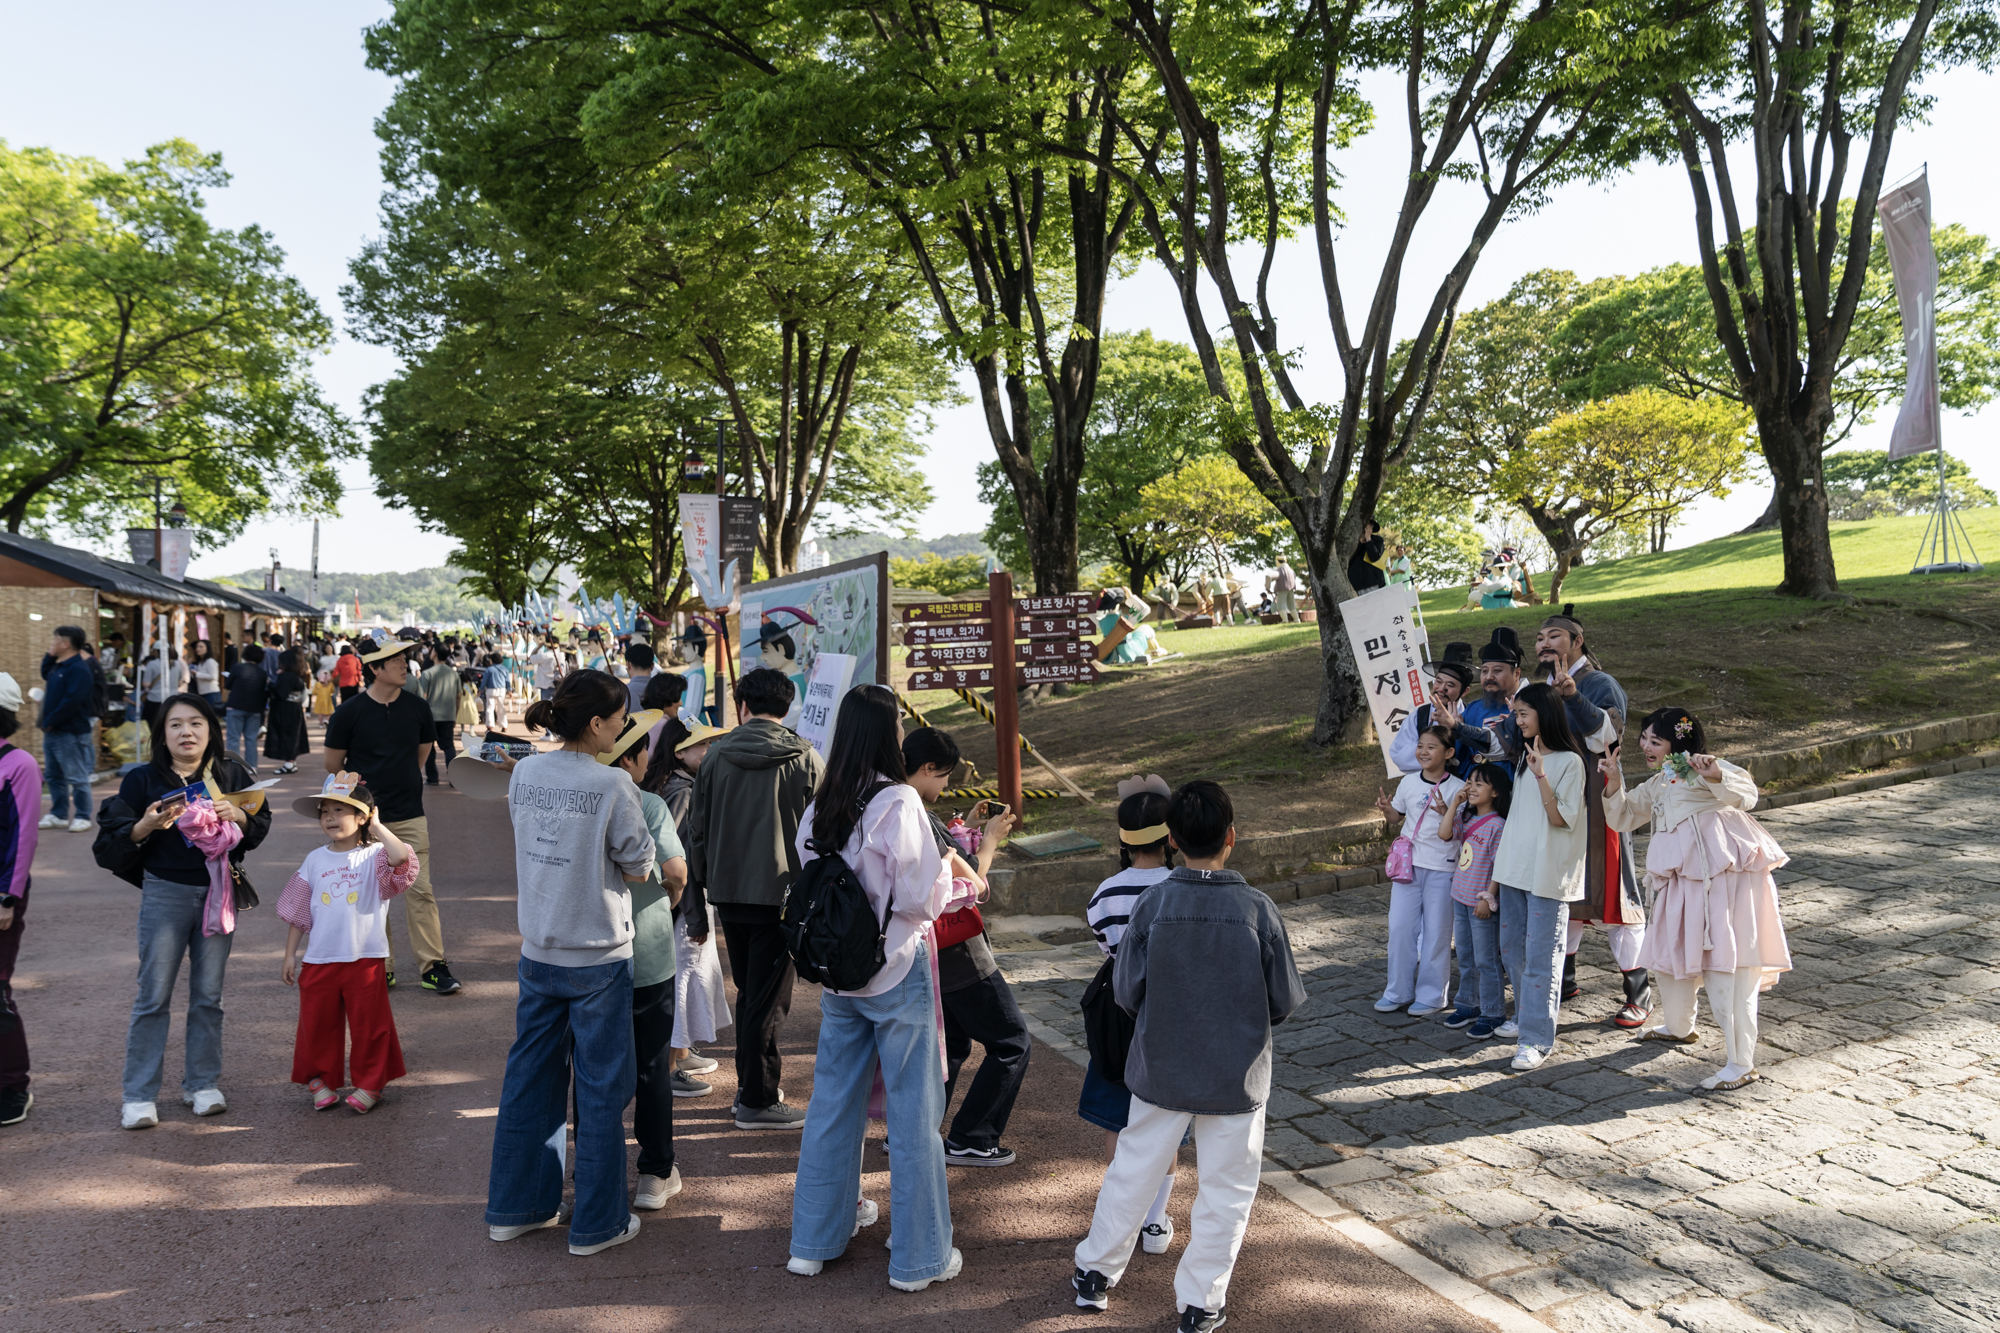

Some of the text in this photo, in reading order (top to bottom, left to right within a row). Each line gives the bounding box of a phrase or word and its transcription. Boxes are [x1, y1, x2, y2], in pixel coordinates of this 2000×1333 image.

[928, 603, 982, 614] 국립진주박물관
[1020, 597, 1075, 610] 영남포정사
[959, 626, 984, 636] 의기사
[931, 647, 988, 660] 야외공연장
[514, 783, 603, 814] DISCOVERY
[321, 869, 336, 878] WRITE
[1201, 869, 1212, 879] 12
